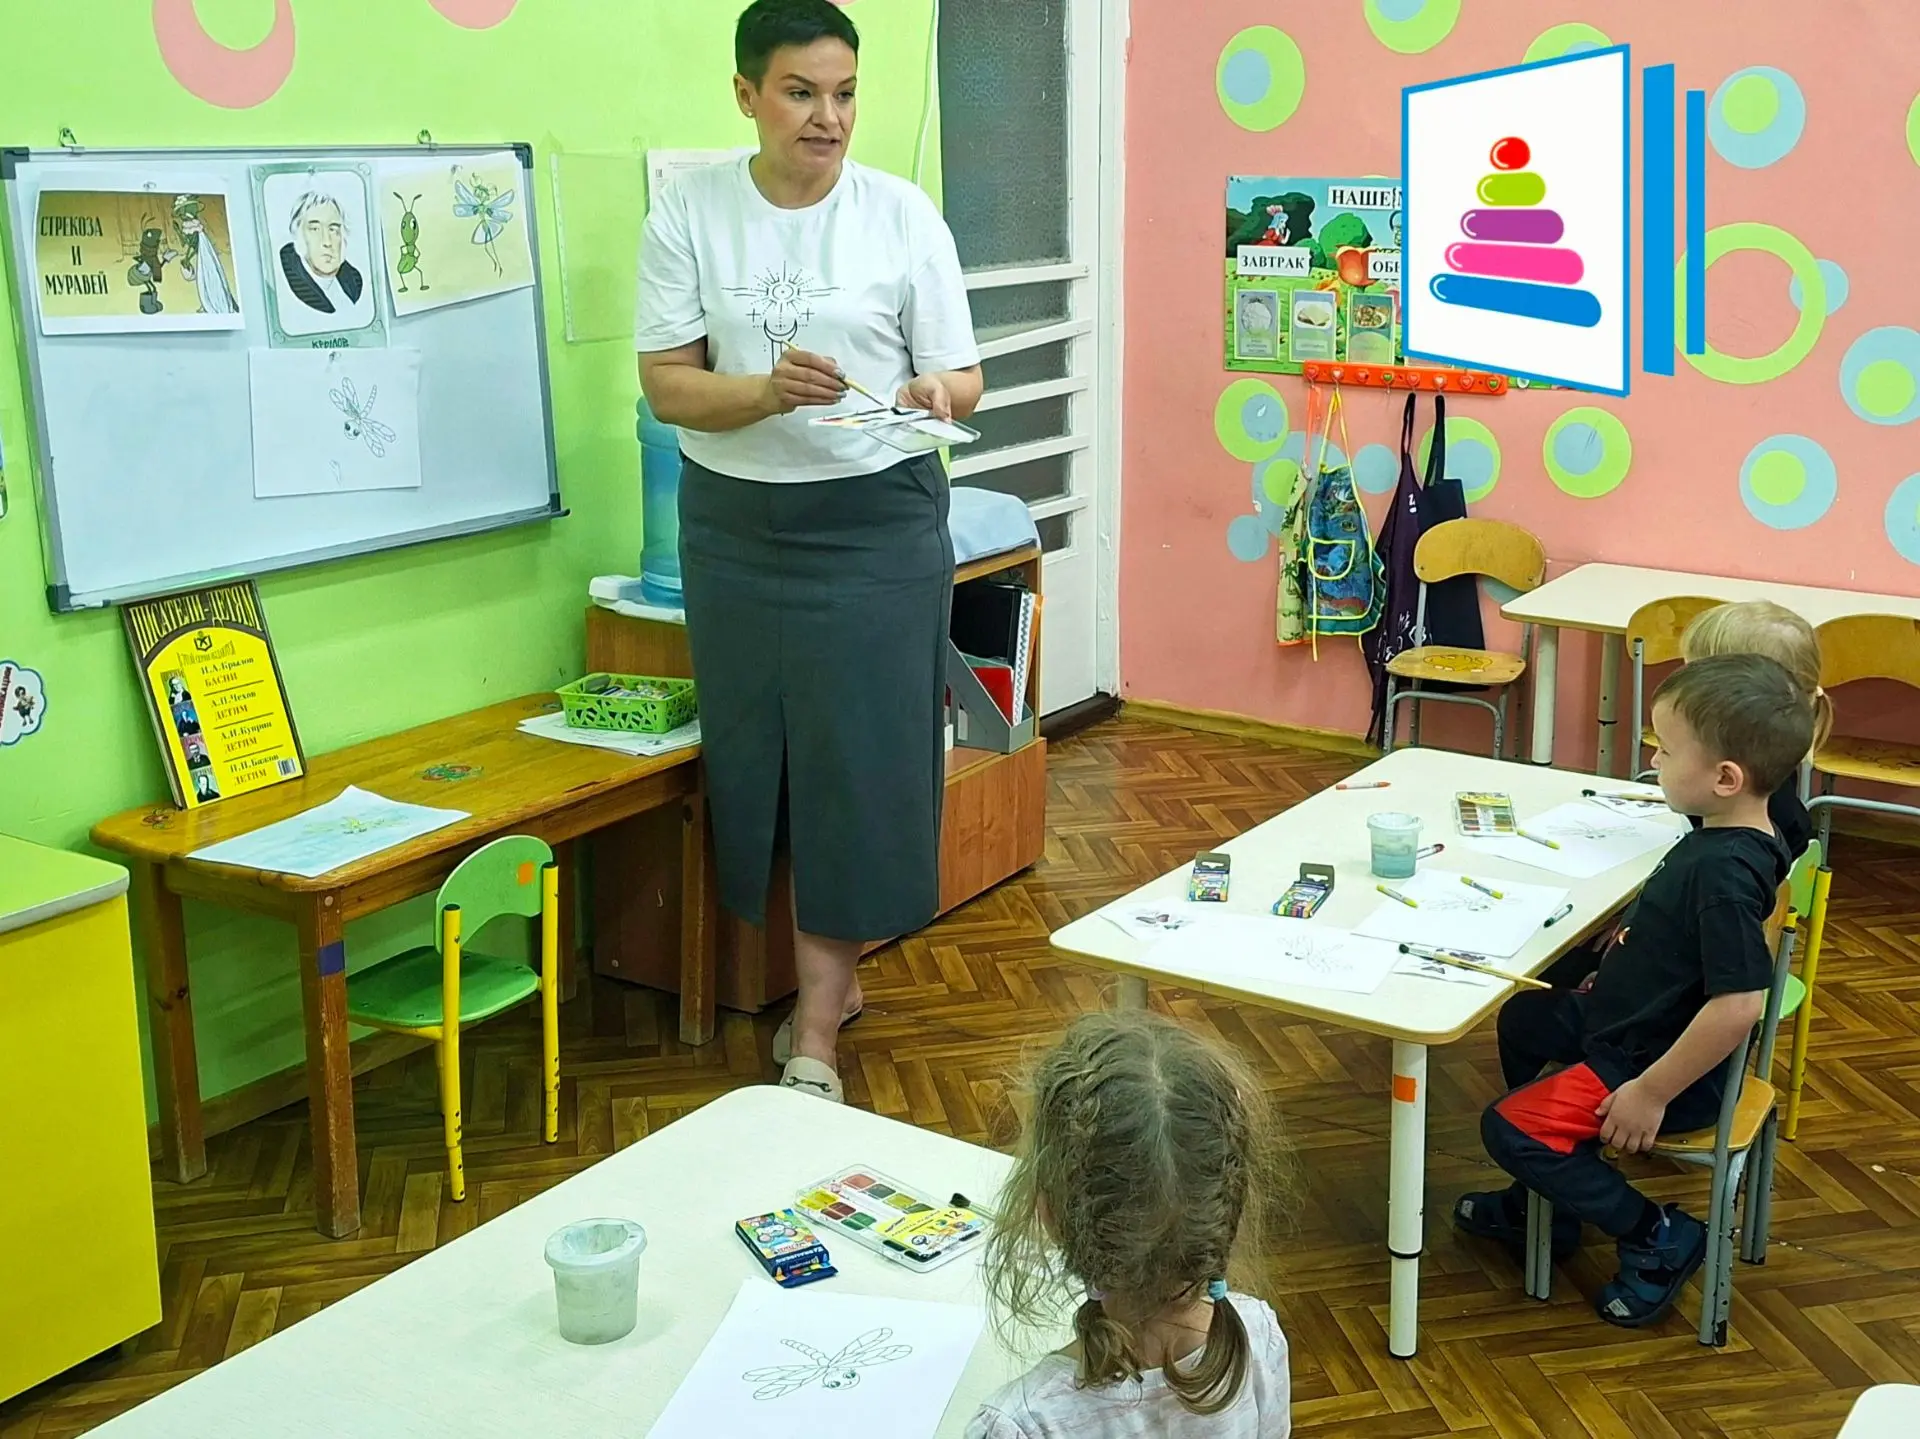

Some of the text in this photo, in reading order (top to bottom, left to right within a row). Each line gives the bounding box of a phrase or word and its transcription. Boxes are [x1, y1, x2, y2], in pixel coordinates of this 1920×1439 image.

[1331, 189, 1391, 207] НАШЕ
[40, 215, 104, 237] СТРЕКОЗА
[71, 245, 82, 266] И
[1241, 255, 1305, 269] ЗАВТРАК
[44, 271, 108, 296] МУРАВЕЙ
[215, 704, 248, 721] ДЕТЯМ
[225, 737, 258, 754] ДЕТЯМ
[234, 769, 267, 786] ДЕТЯМ
[944, 1210, 962, 1219] 12
